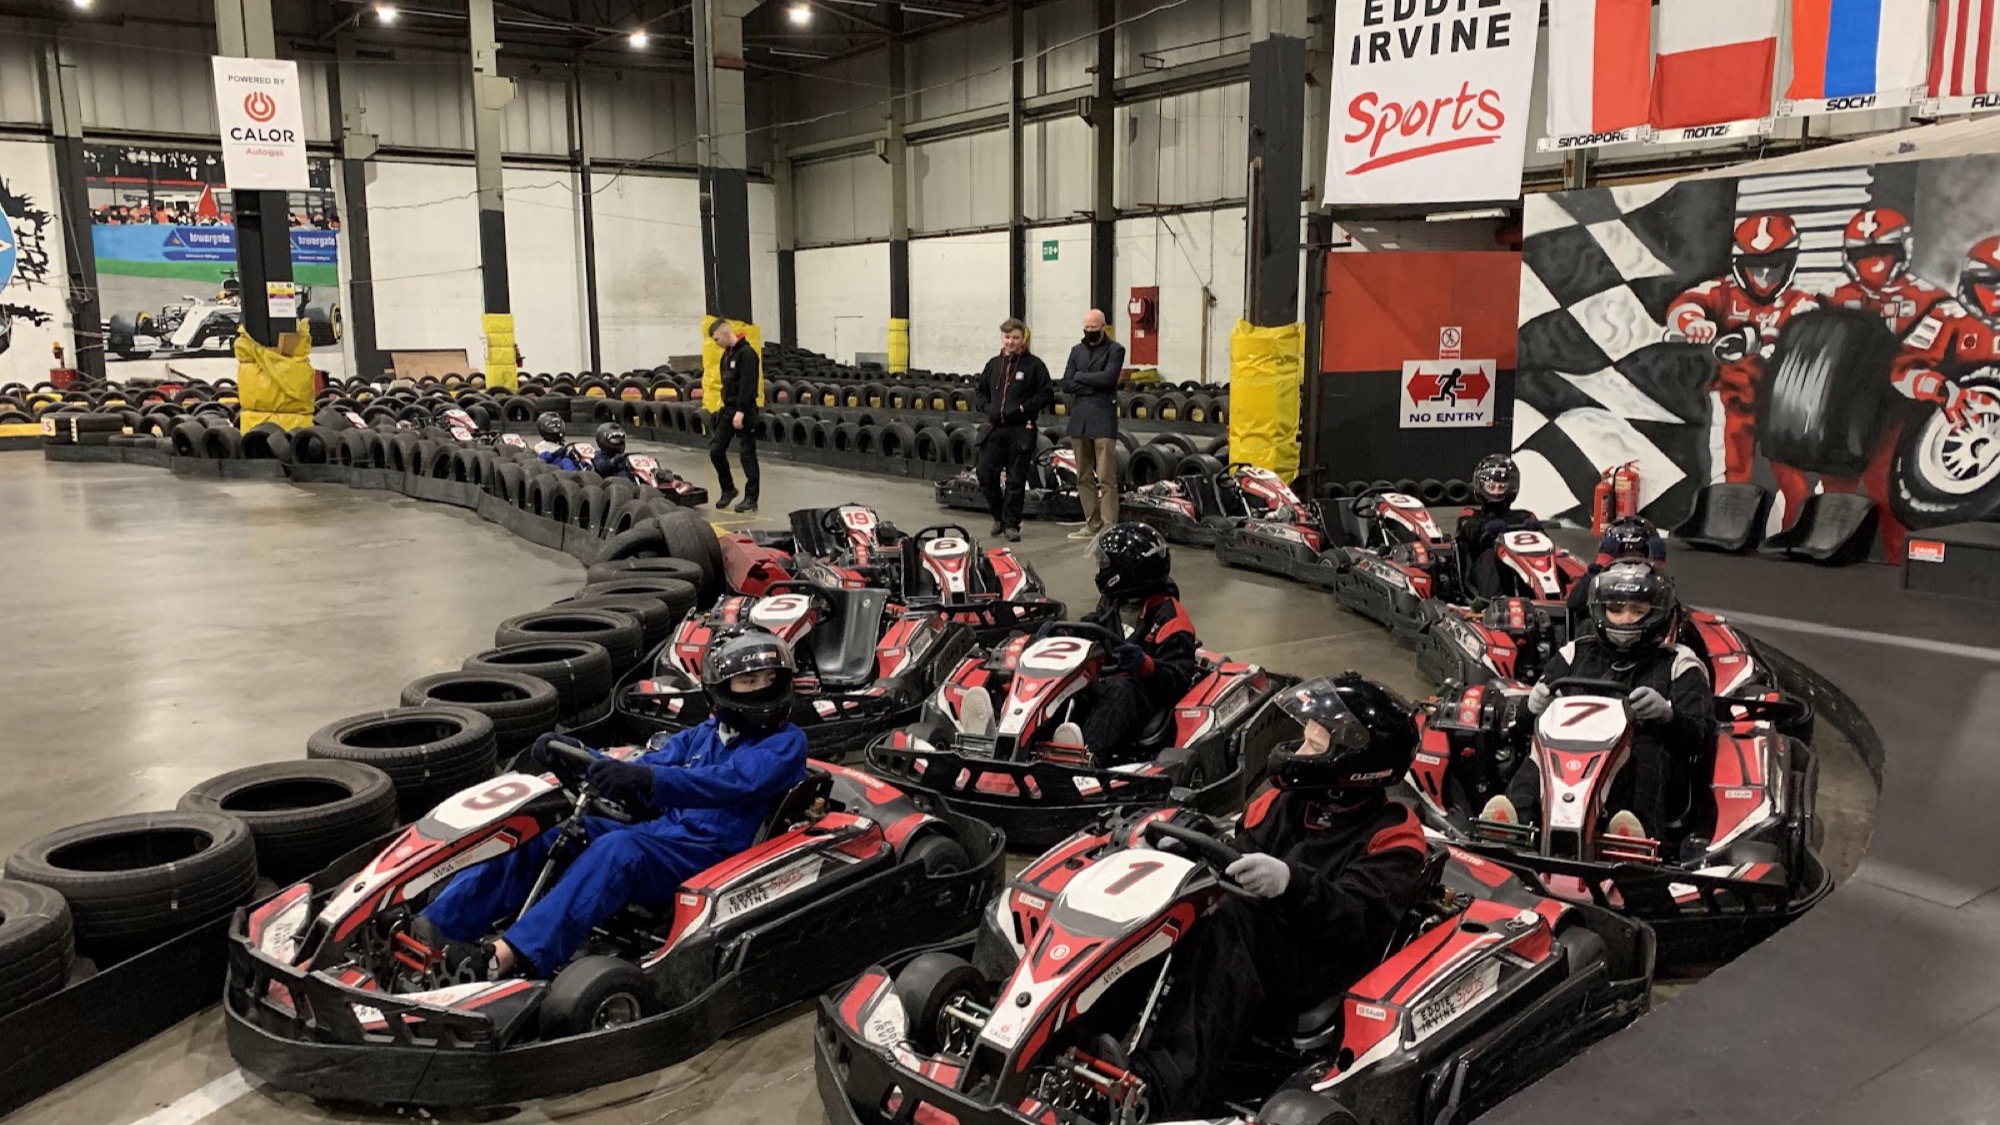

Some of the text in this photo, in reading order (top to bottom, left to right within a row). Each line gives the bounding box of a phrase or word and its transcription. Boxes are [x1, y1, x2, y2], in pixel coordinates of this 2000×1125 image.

[1350, 12, 1511, 66] IRVINE
[227, 75, 285, 85] POWERED BY
[1825, 95, 1877, 111] SOCHI
[1971, 93, 2000, 109] AU
[1344, 81, 1505, 158] Sports
[230, 127, 295, 143] CALOR
[1557, 131, 1630, 148] SINGAPORE
[245, 148, 284, 157] Autogas
[1409, 412, 1484, 423] NO ENTRY
[846, 512, 869, 526] 19
[934, 540, 959, 550] 6
[1513, 533, 1540, 546] 8
[763, 597, 801, 612] 5
[1032, 640, 1083, 660] 2
[1560, 702, 1610, 728] 7
[461, 781, 531, 811] 9
[1104, 860, 1164, 896] 1
[729, 891, 769, 914] IRVINE
